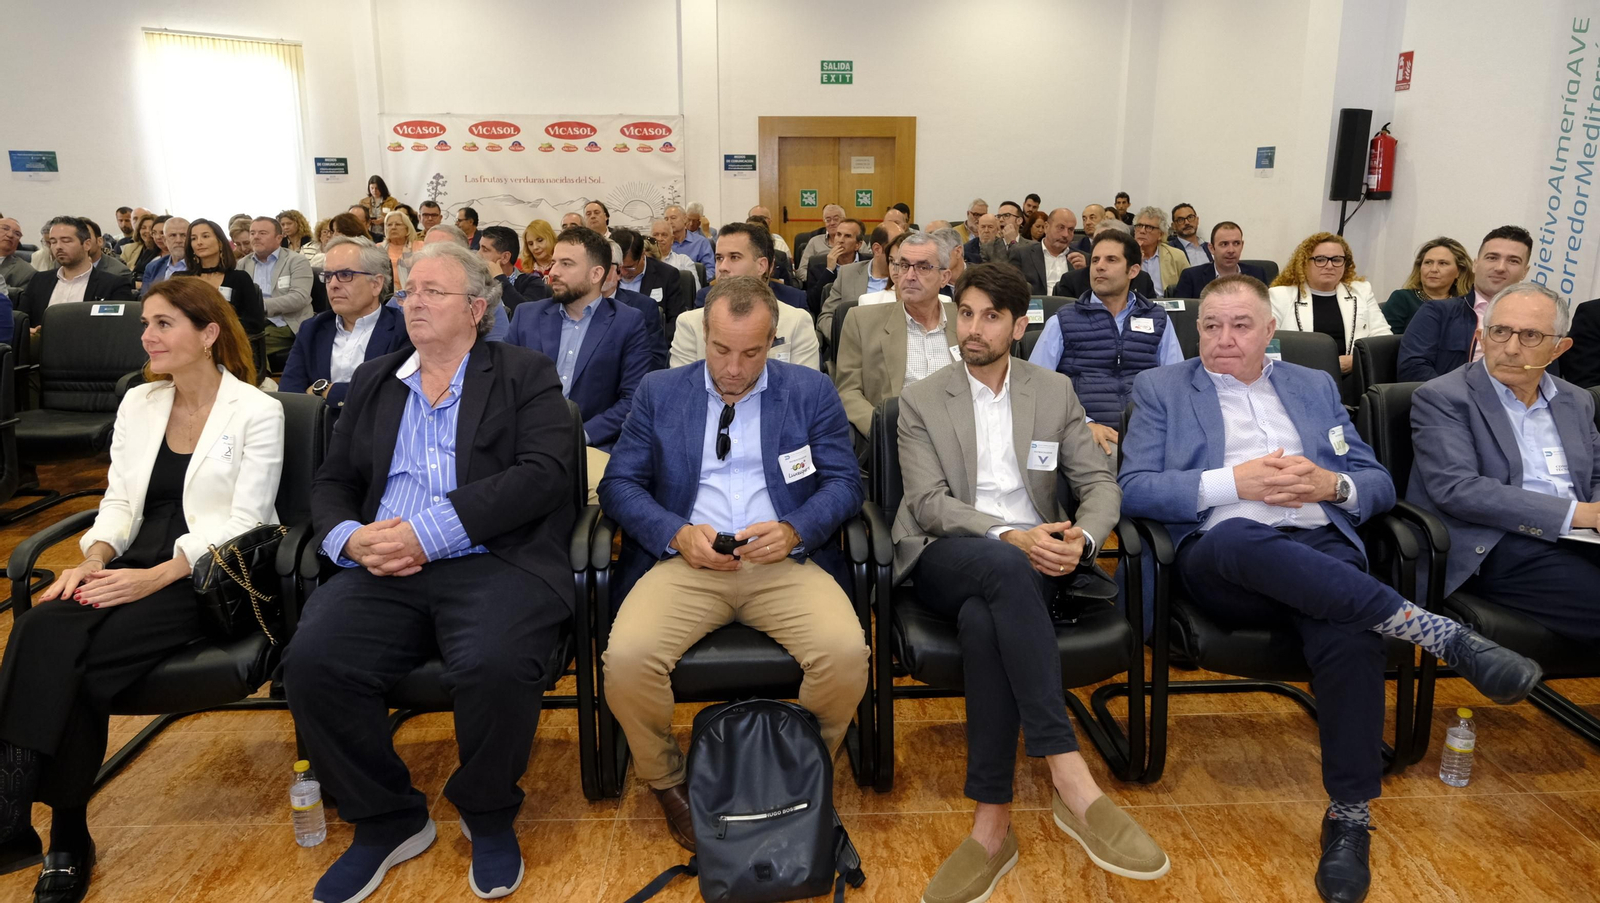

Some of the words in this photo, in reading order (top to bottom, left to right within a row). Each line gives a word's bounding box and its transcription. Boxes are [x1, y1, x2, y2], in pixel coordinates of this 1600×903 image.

[823, 62, 851, 70] SALIDA
[822, 74, 851, 83] EXIT
[396, 125, 443, 135] VICASOL
[471, 125, 518, 135] VICASOL
[547, 126, 595, 136] VICASOL
[623, 126, 669, 136] VICASOL
[1531, 17, 1590, 288] bjetivoAlmeríaAVE
[464, 175, 479, 183] Las
[479, 175, 503, 183] frutas
[509, 176, 545, 184] verduras
[546, 176, 574, 184] nacidas
[575, 176, 587, 184] del
